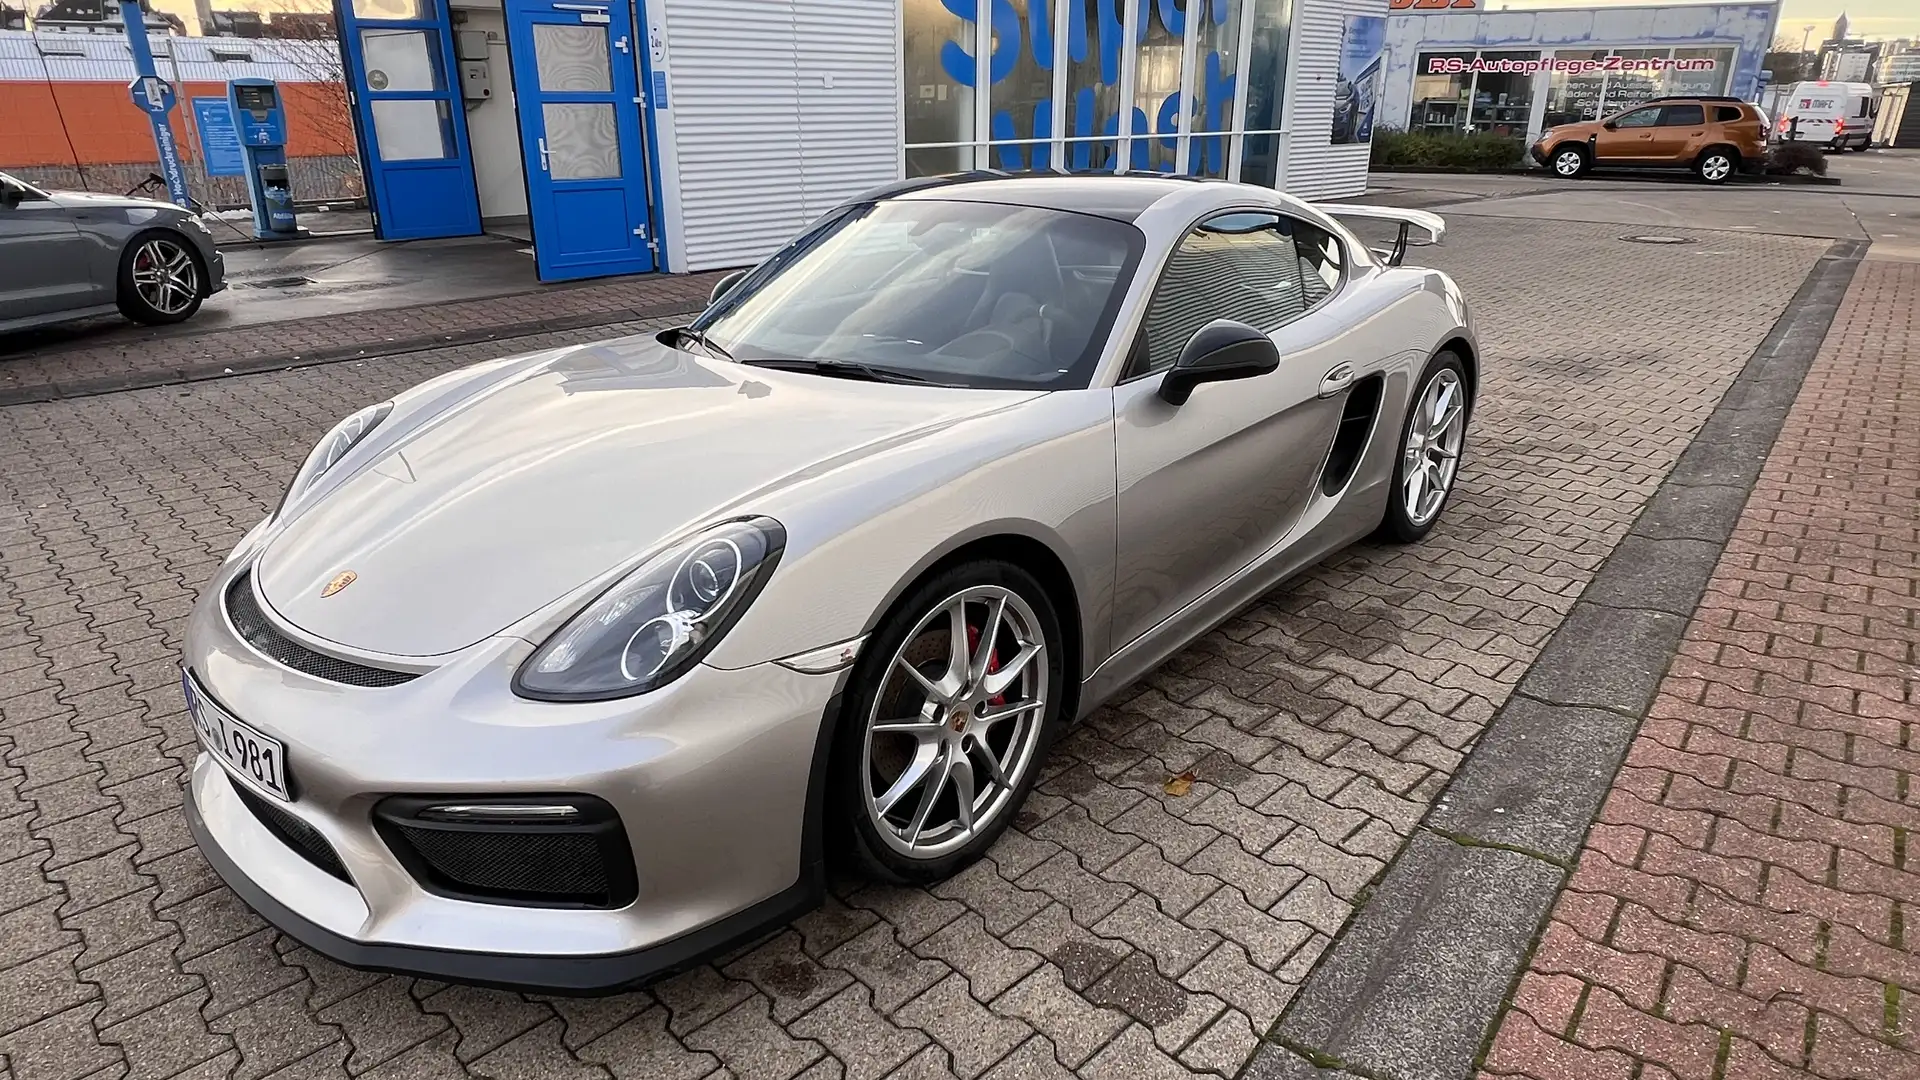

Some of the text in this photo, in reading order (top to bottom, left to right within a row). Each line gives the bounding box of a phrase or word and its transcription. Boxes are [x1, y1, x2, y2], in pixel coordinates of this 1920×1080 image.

[1428, 55, 1716, 76] RS-Autopflege-Zentrum
[1595, 90, 1616, 98] ud
[232, 730, 282, 793] 981
